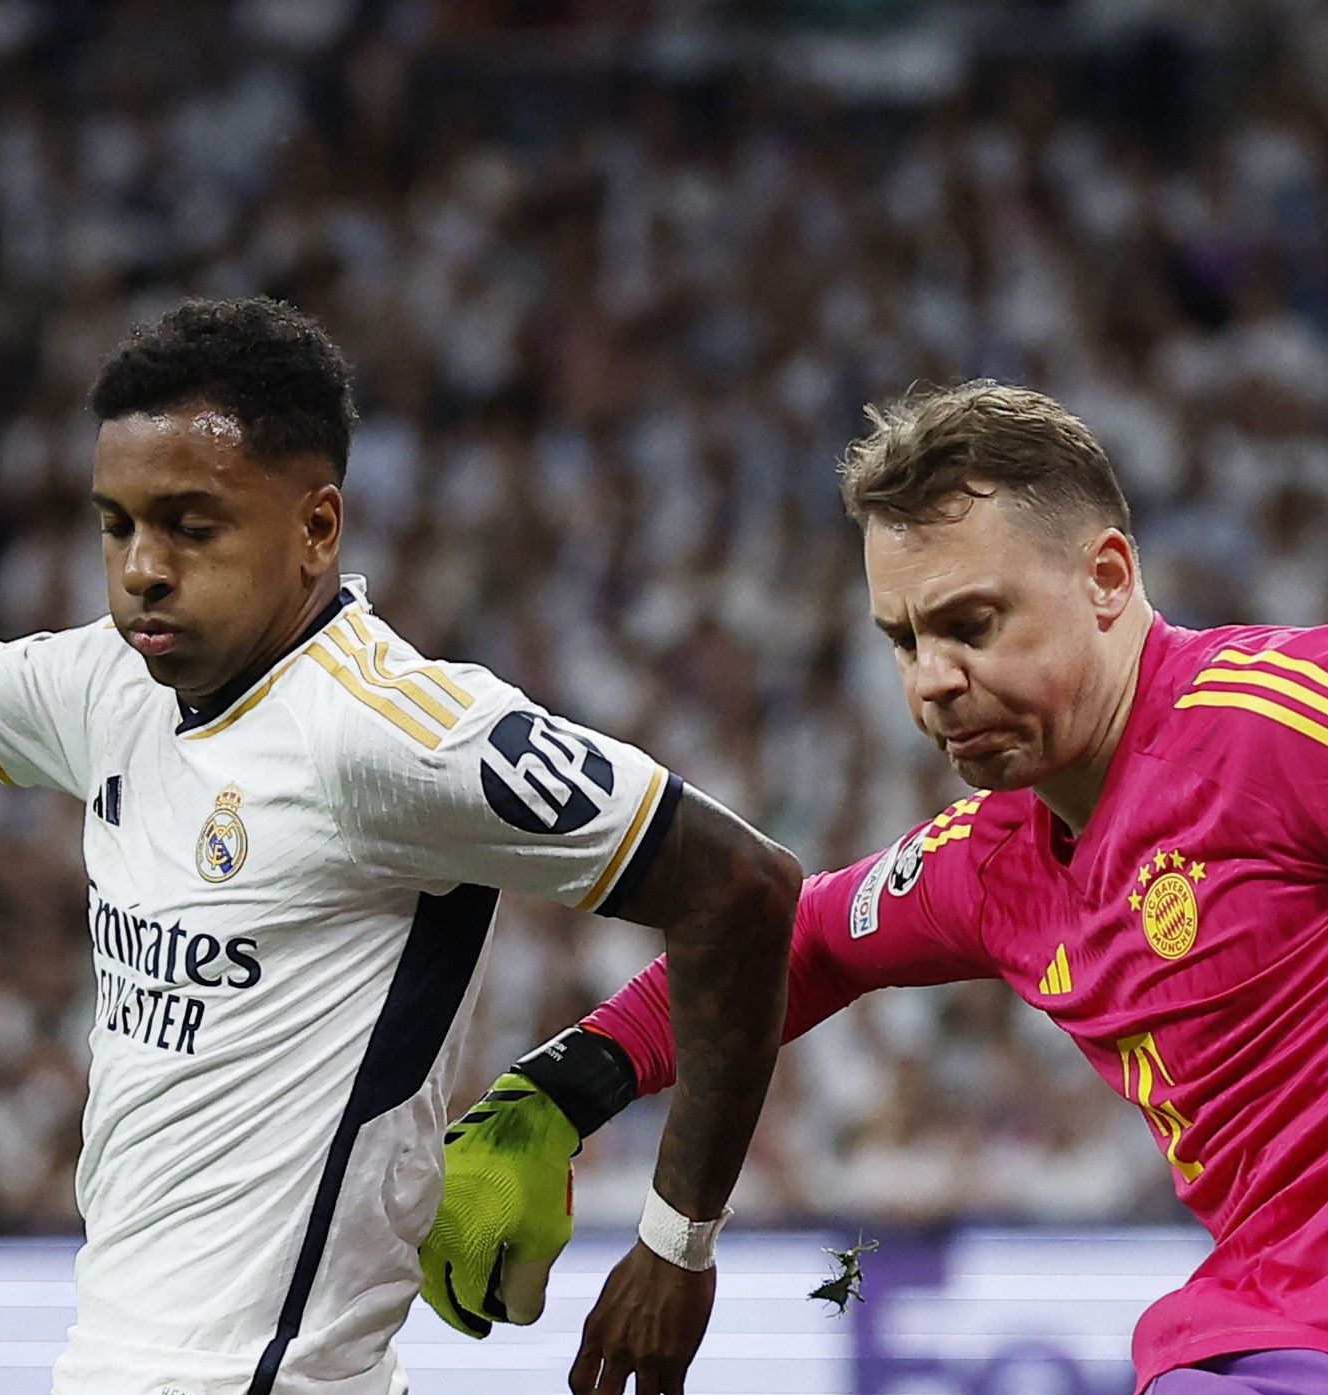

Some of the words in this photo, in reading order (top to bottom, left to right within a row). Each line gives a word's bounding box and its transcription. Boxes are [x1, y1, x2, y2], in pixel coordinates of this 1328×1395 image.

[480, 711, 614, 834] hp
[1147, 900, 1157, 919] FC
[1154, 880, 1190, 903] BAYERN
